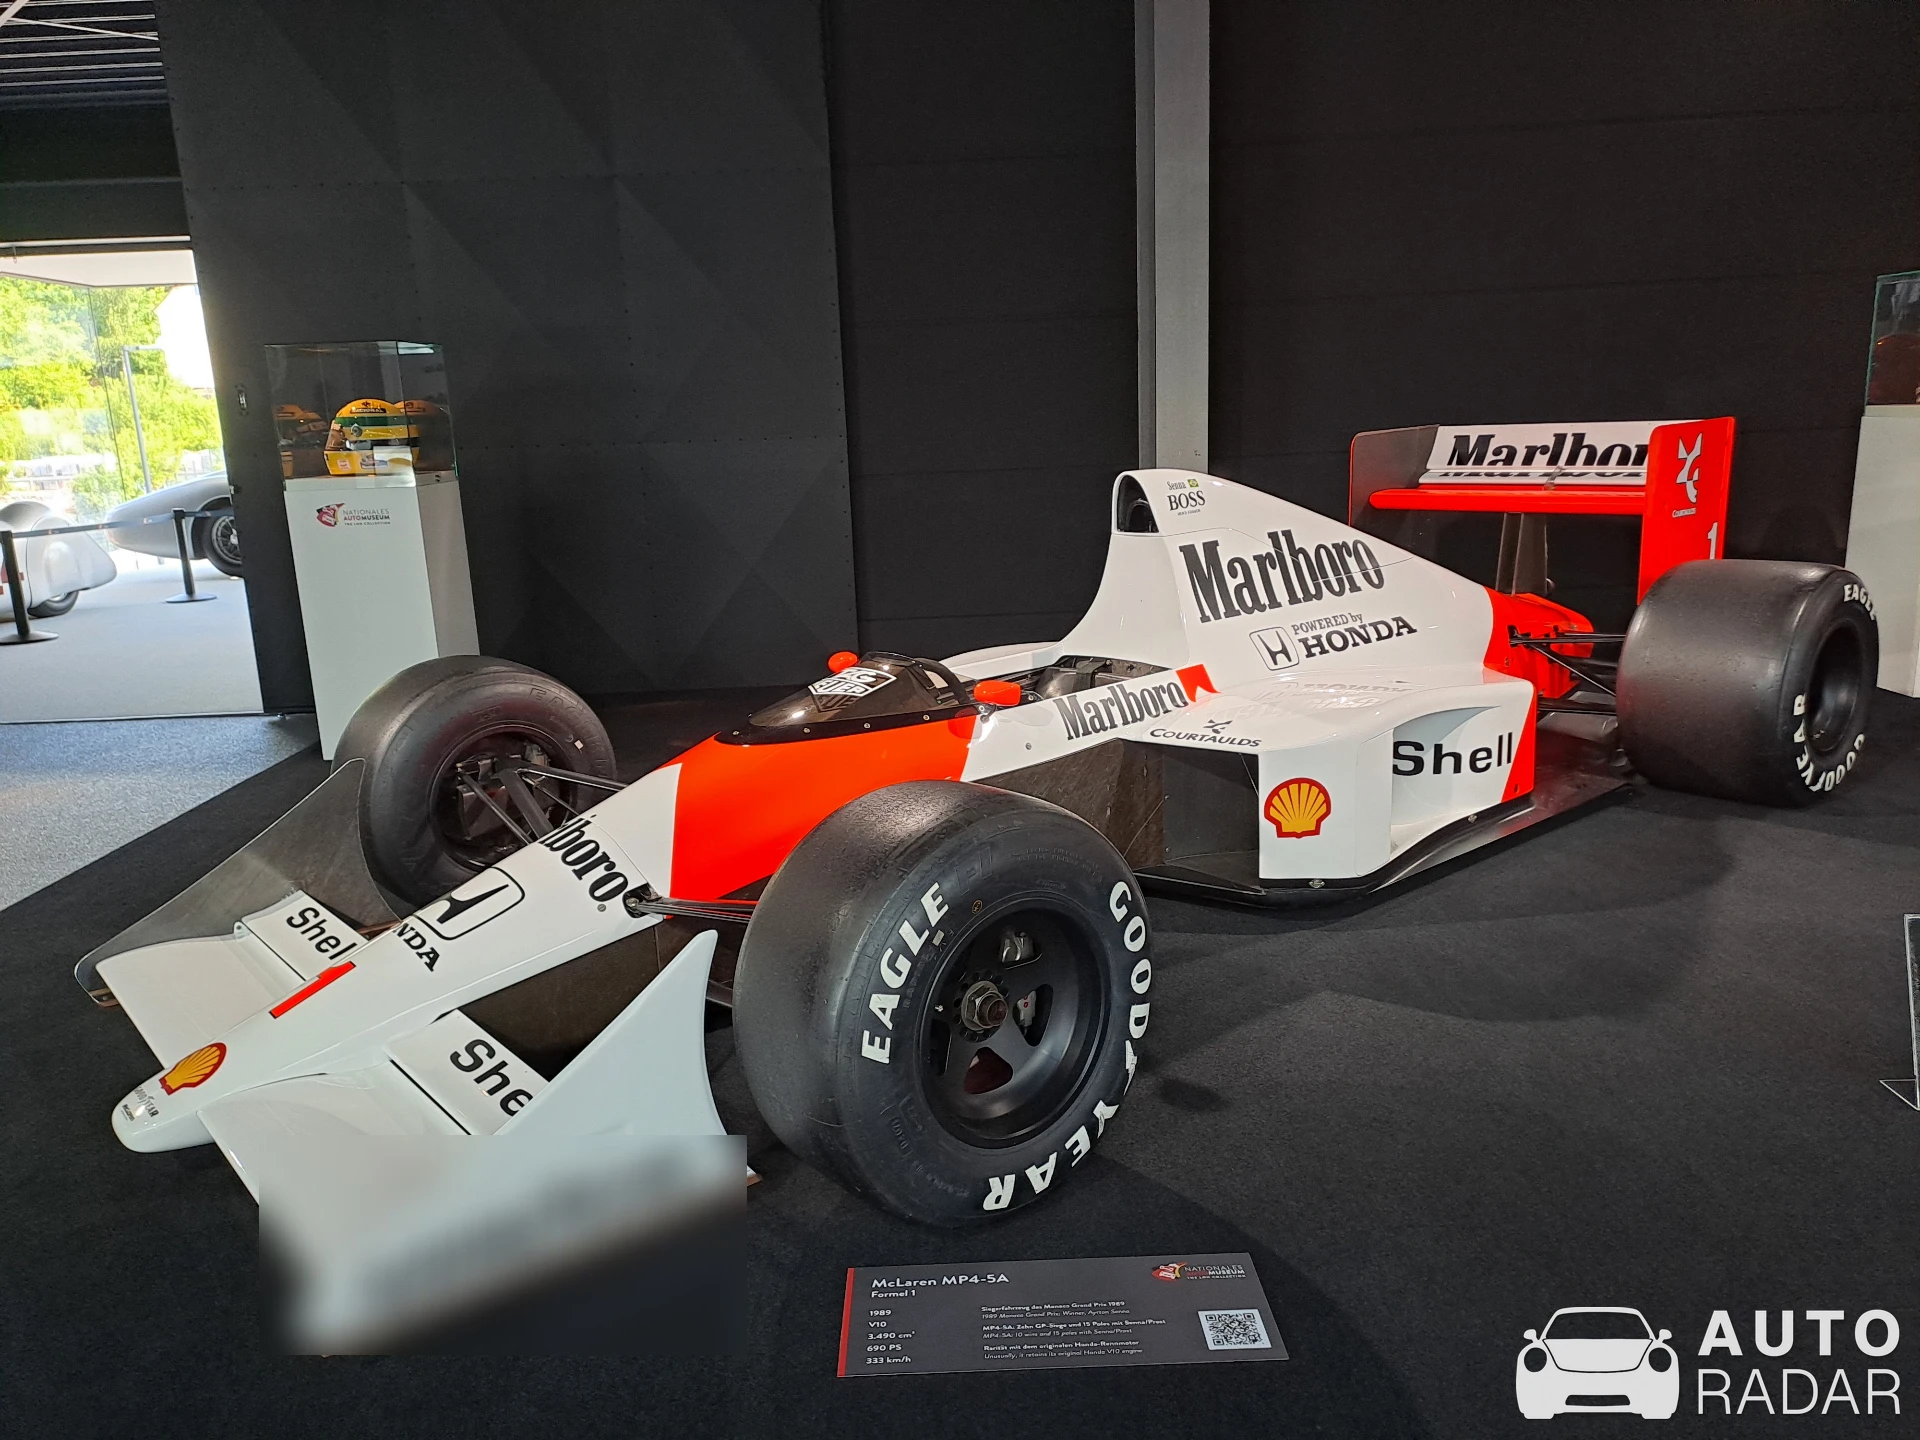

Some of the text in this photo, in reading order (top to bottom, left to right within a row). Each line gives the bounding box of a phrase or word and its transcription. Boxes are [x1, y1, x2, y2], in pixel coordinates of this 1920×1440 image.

[1167, 490, 1205, 511] BOSS
[1179, 529, 1385, 623] Marlboro
[1291, 612, 1363, 635] POWERED by
[1298, 615, 1418, 659] HONDA
[1054, 680, 1189, 740] Marlboro
[1150, 728, 1262, 748] COURTAULDS
[1392, 732, 1513, 777] Shell
[286, 907, 358, 960] Shel
[392, 922, 440, 972] NDA
[861, 882, 949, 1065] EAGLE
[983, 881, 1153, 1211] GOODYEAR
[450, 1039, 533, 1117] She
[1184, 1264, 1243, 1272] NATIONALES
[871, 1273, 1009, 1288] McLaren MP4-5A
[871, 1289, 916, 1298] Formel 1
[869, 1309, 892, 1317] 1989
[866, 1343, 902, 1352] 690 PS
[867, 1332, 896, 1340] 3.490
[866, 1355, 912, 1364] 333 km/h
